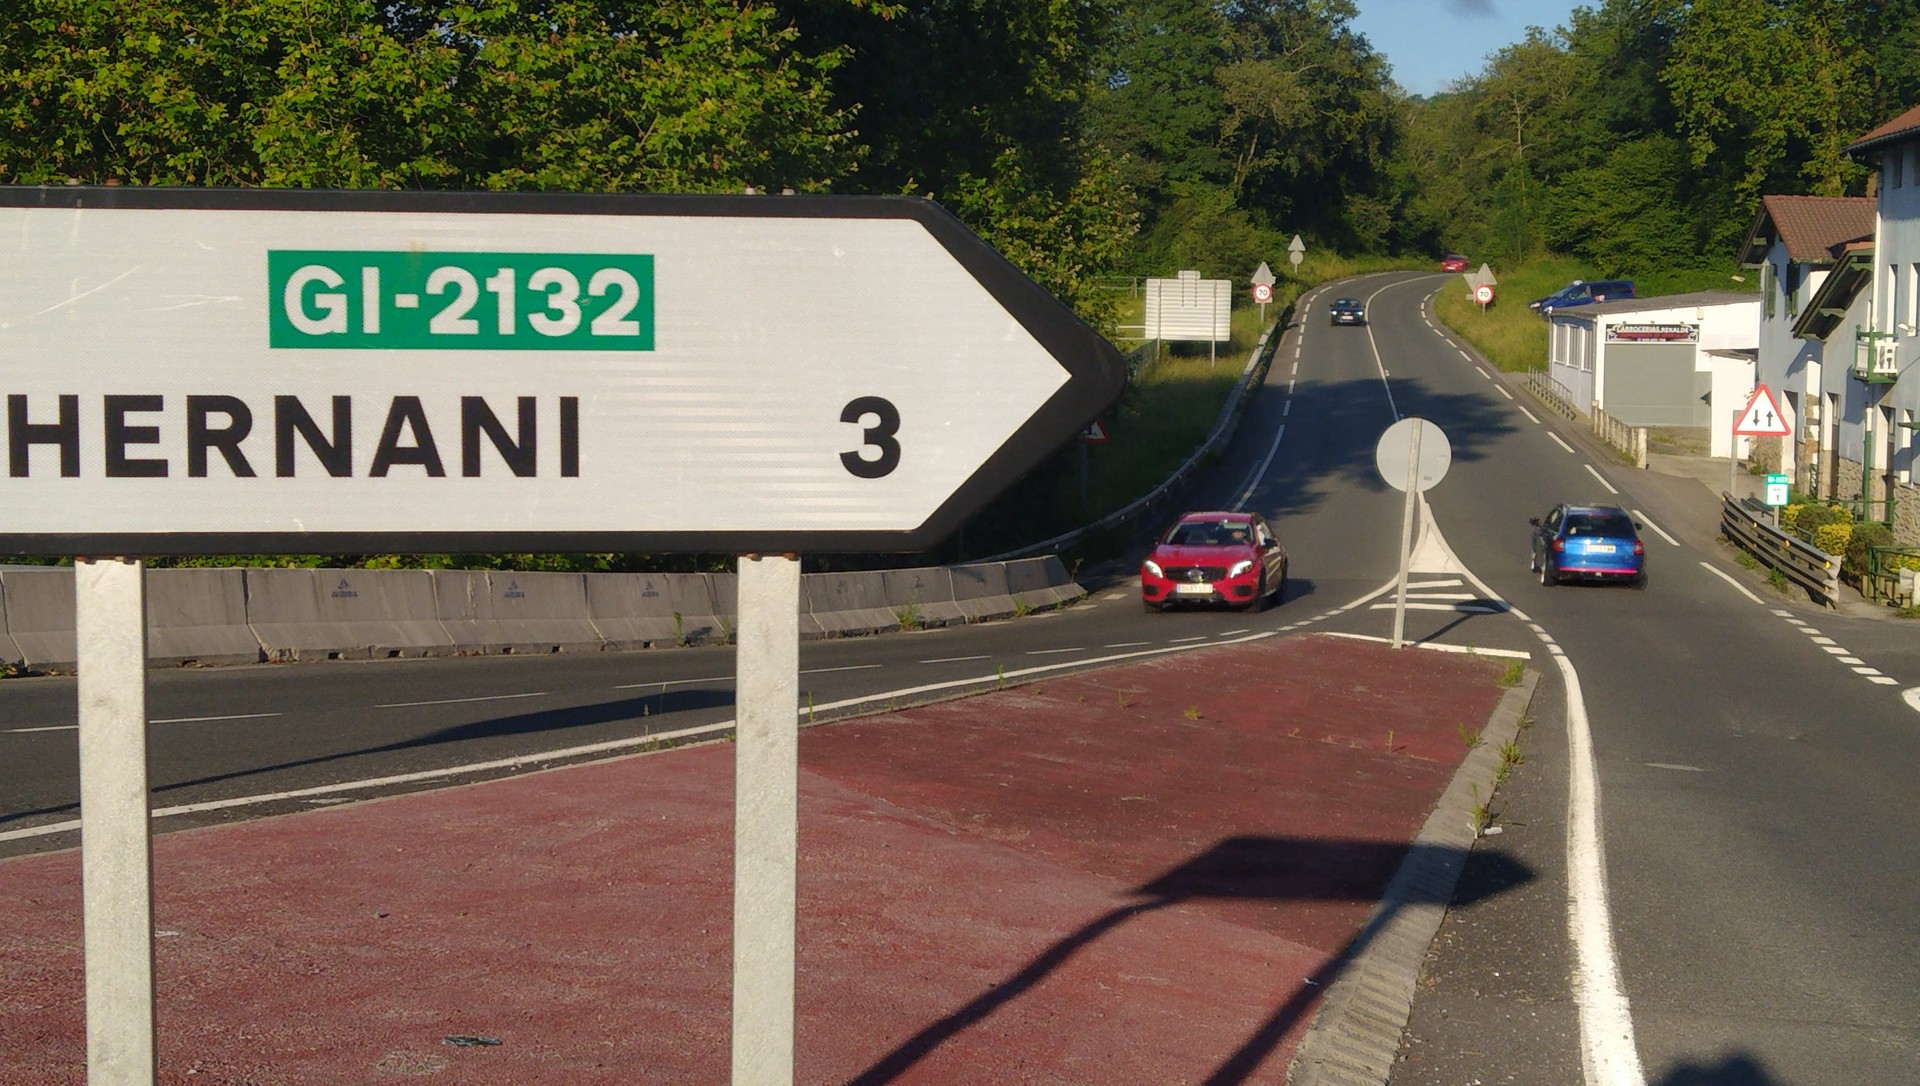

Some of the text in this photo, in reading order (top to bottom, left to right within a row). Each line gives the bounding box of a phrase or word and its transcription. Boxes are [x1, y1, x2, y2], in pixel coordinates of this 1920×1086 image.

[283, 264, 641, 338] GI-2132
[8, 394, 901, 478] HERNANI 3
